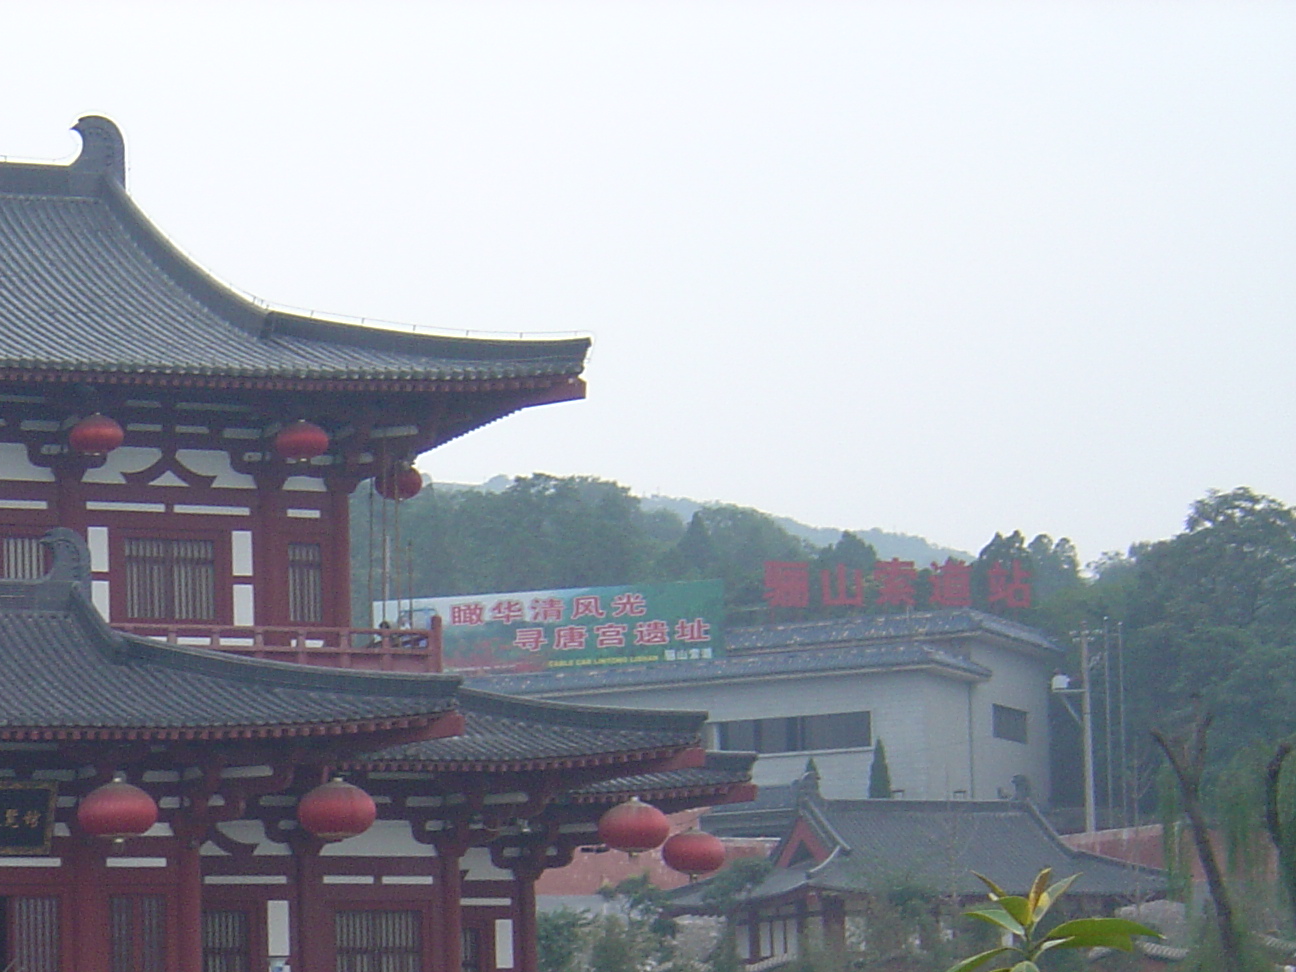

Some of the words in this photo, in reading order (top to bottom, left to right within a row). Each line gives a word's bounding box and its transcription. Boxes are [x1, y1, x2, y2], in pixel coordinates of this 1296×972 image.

[762, 557, 1032, 608] 骊山索道站
[450, 593, 647, 626] 瞰华清风光
[513, 618, 711, 652] 寻唐宫遗址
